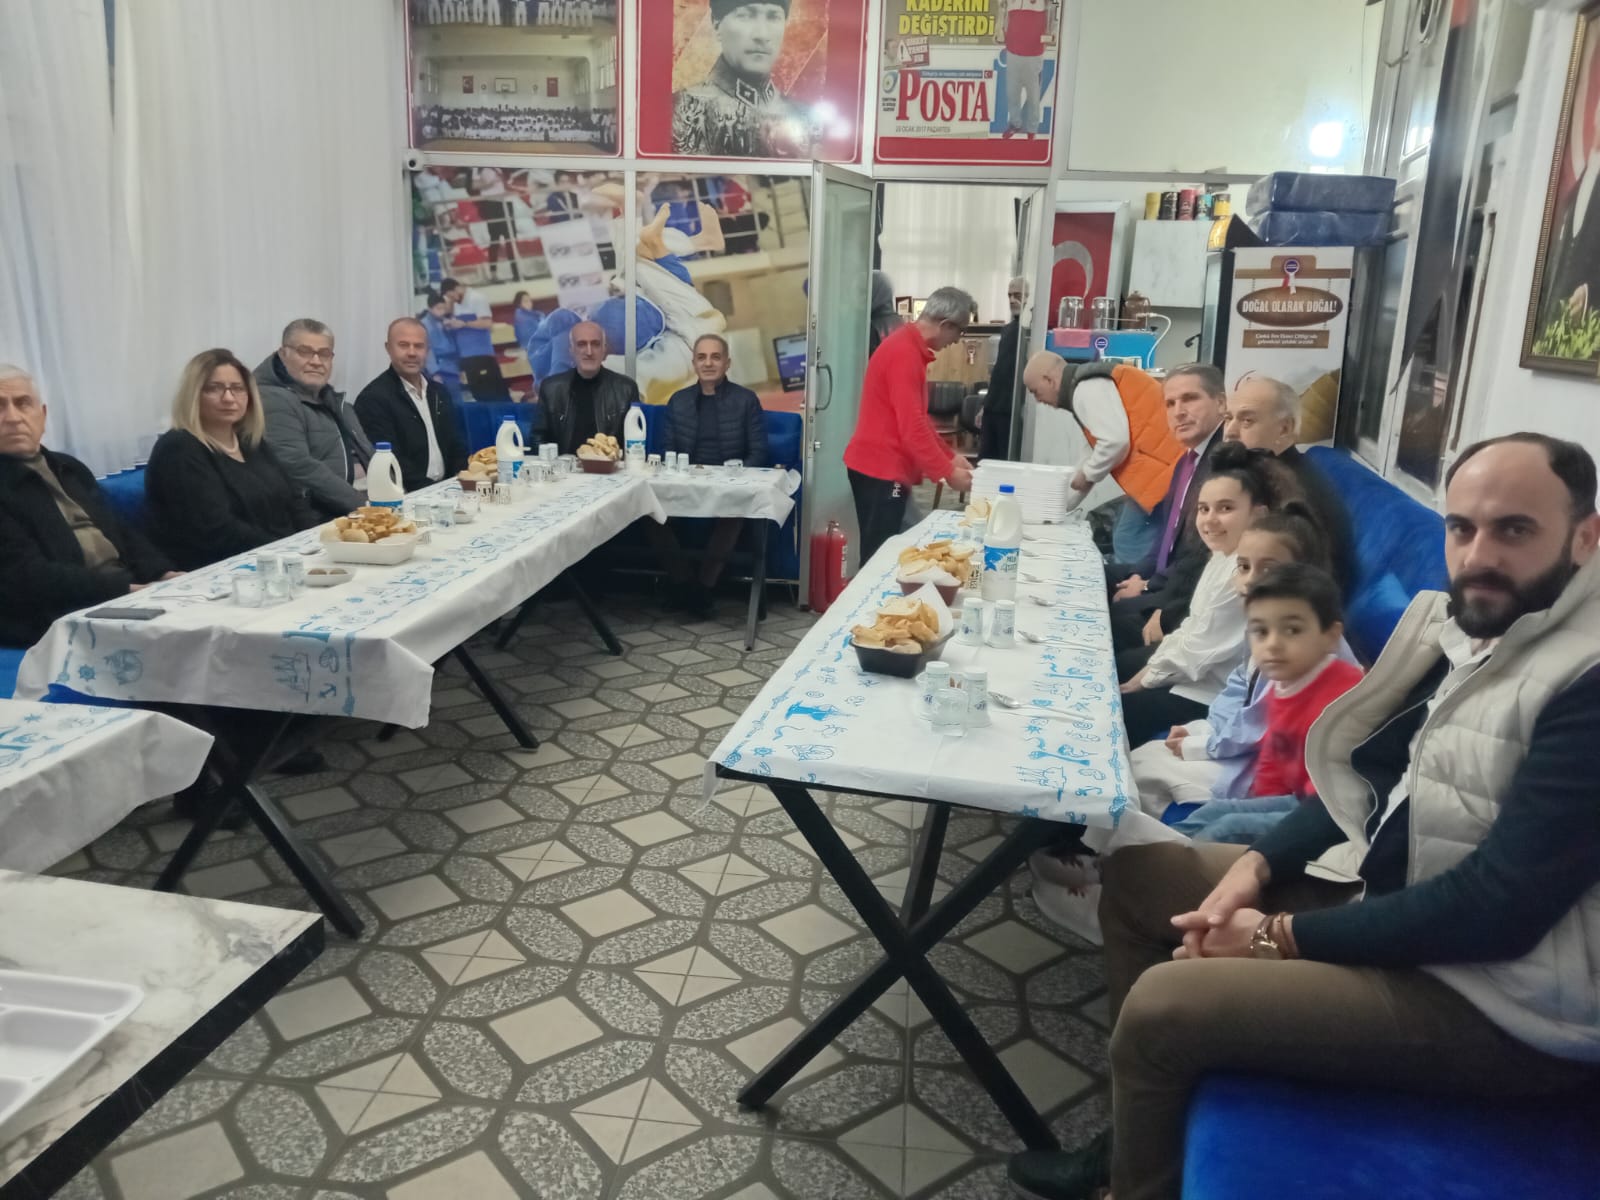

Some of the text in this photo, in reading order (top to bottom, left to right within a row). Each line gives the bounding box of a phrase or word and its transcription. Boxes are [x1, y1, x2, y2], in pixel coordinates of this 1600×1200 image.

[898, 14, 995, 37] DEĞİŞTİRDİ
[896, 69, 990, 122] POSTA
[1242, 299, 1337, 313] DOĞAL OLARAK DOĞAL!
